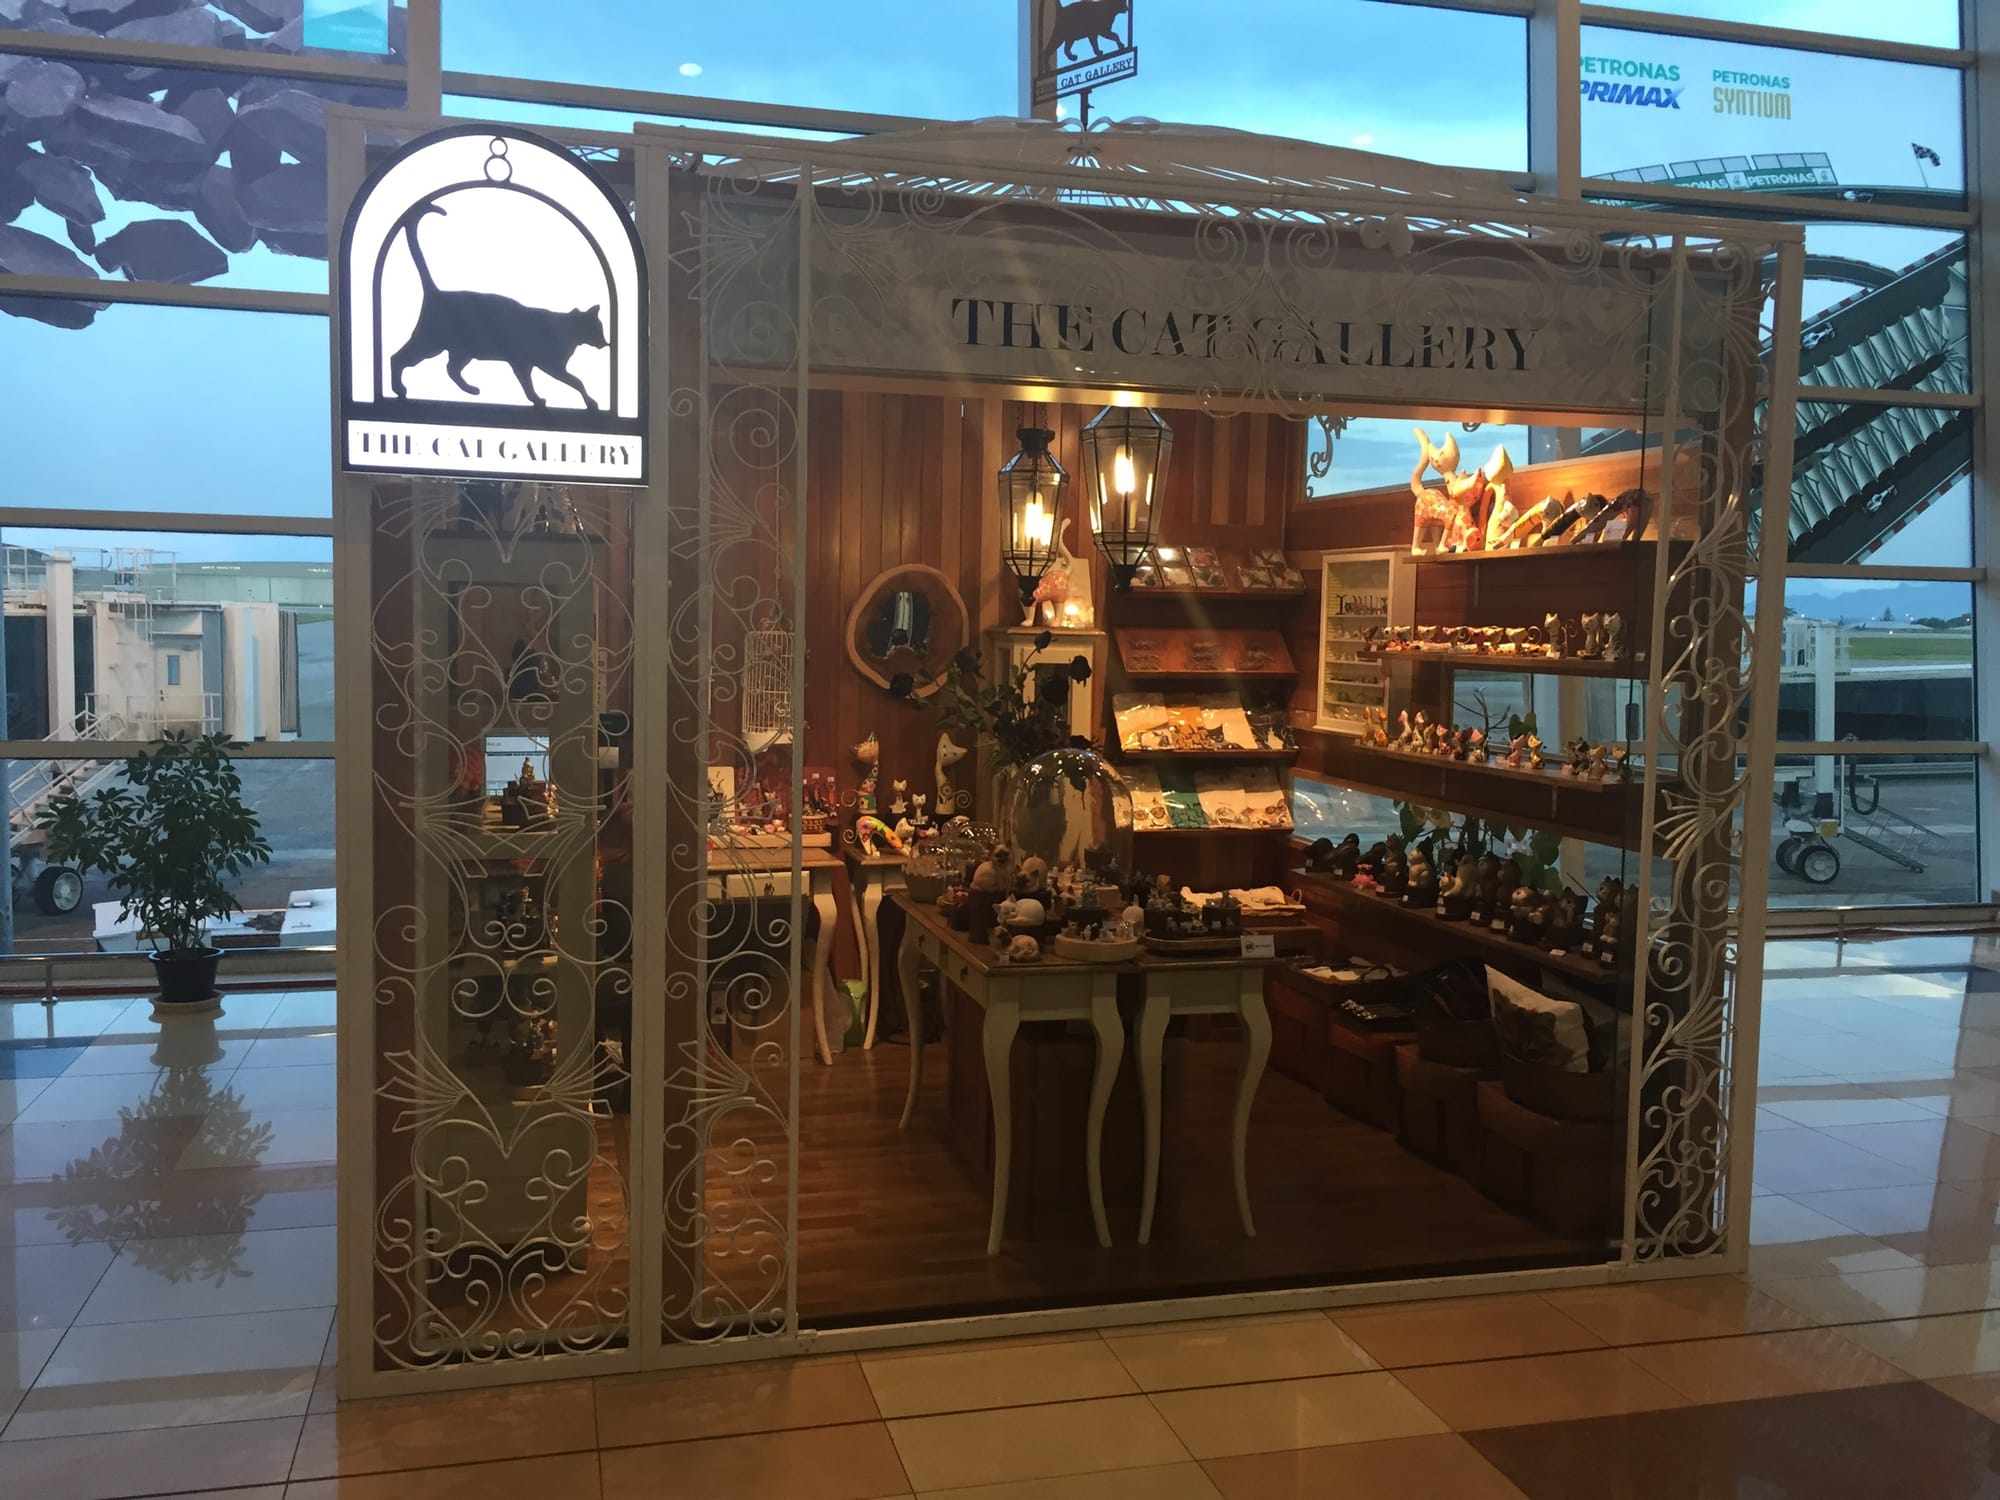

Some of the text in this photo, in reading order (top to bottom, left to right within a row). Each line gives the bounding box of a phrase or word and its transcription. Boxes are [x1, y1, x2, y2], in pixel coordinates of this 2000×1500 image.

[1061, 58, 1133, 88] CAT GALLERY
[1712, 70, 1790, 89] PETRONAS
[1713, 86, 1791, 120] SYNTIUM
[1747, 172, 1816, 187] PETRONAS
[952, 298, 1093, 352] THE
[1112, 308, 1232, 358] CAT
